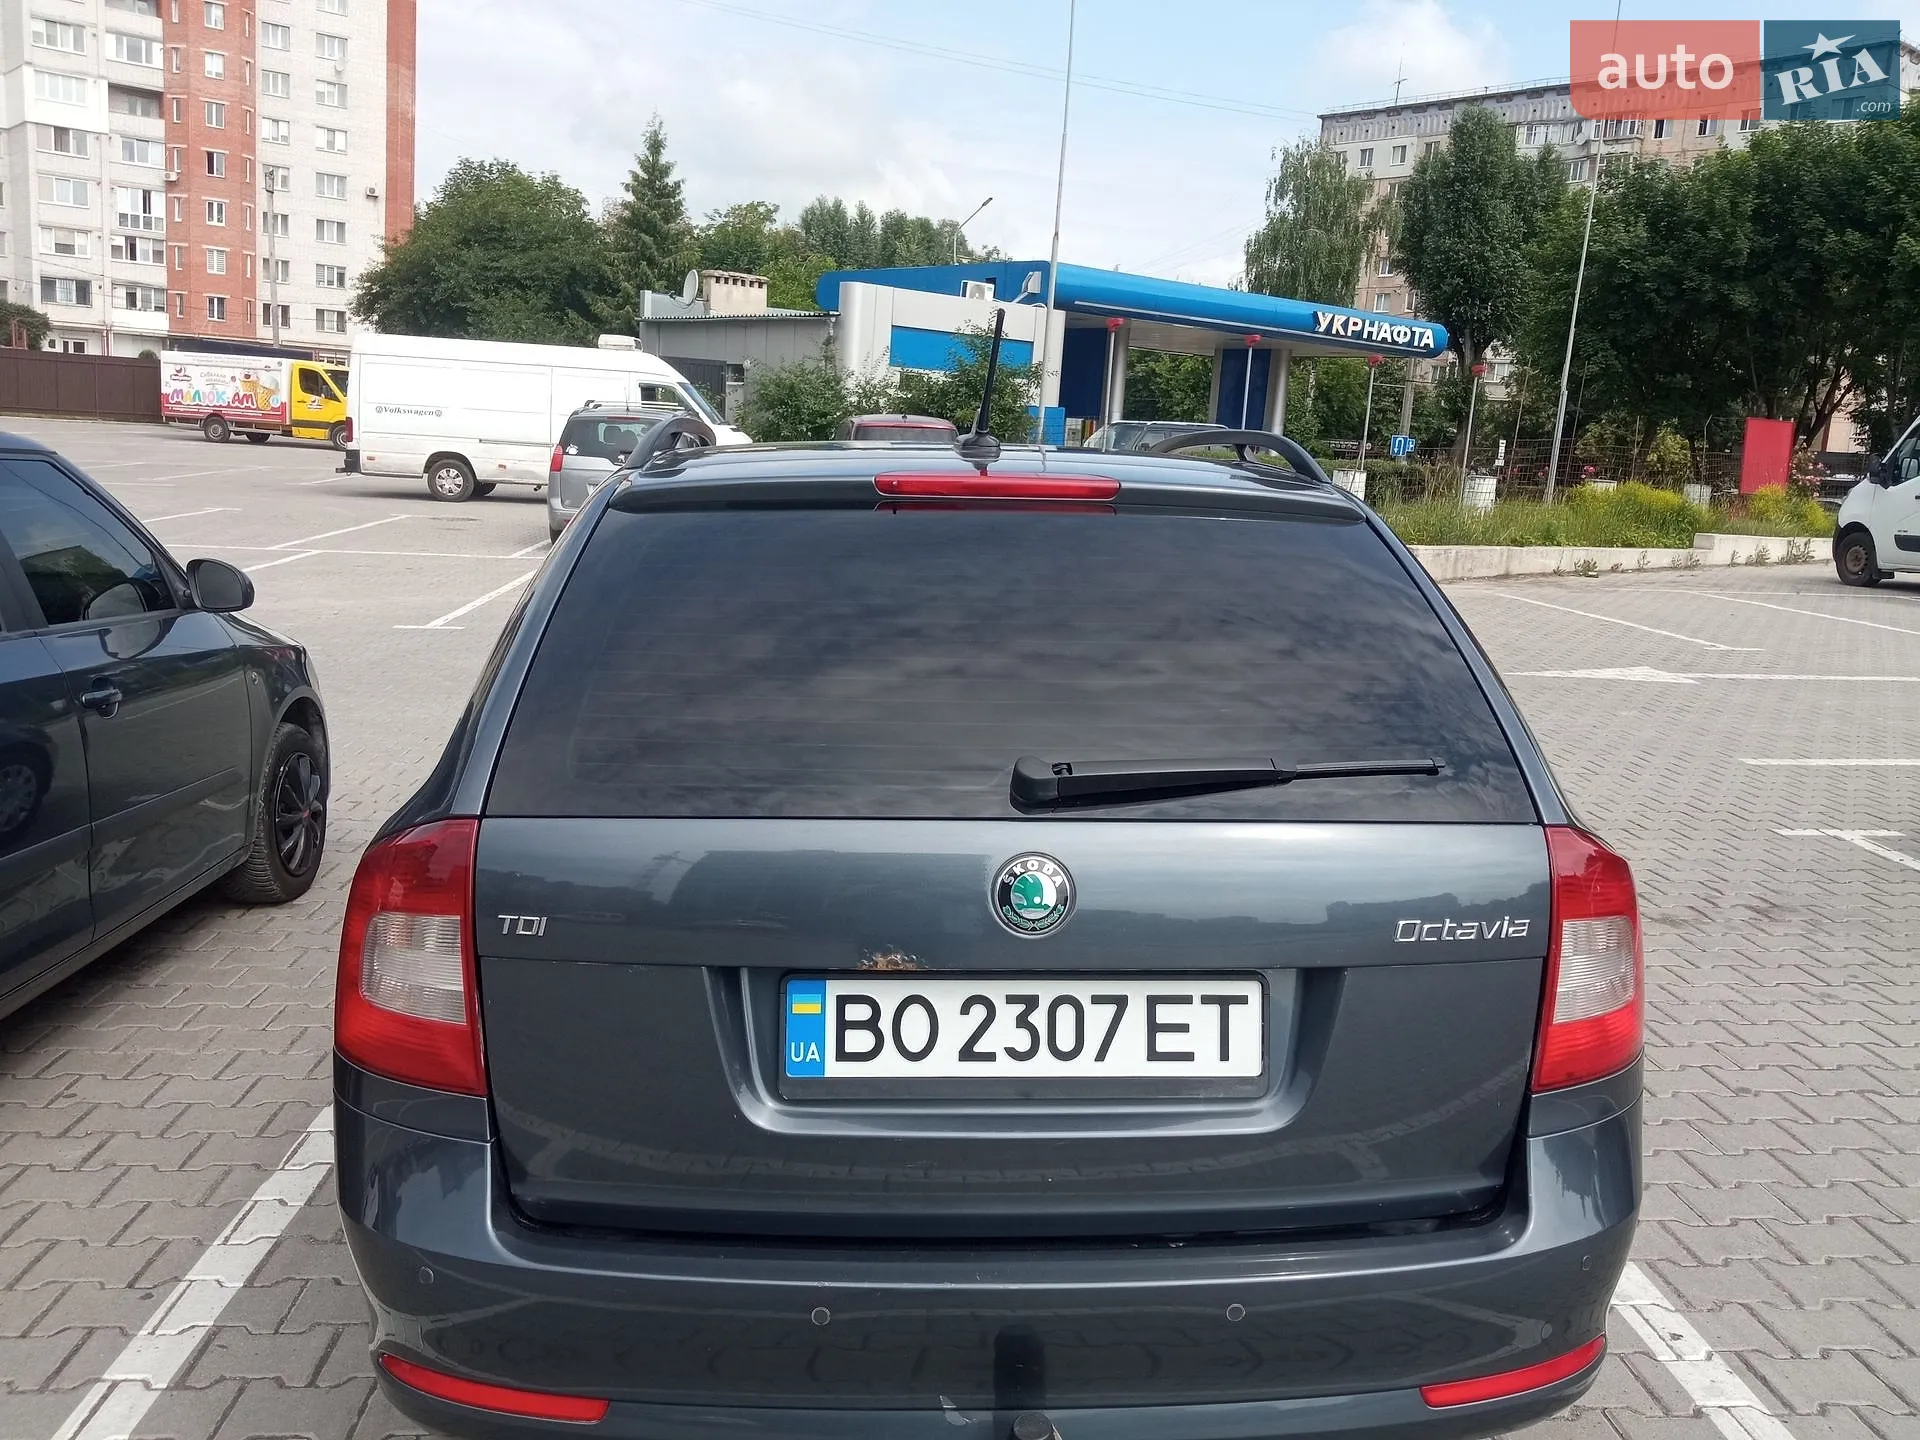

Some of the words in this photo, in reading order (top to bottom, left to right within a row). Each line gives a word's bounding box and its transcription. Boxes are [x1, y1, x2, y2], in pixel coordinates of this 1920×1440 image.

[1315, 311, 1435, 349] УКРНАФТА
[383, 405, 434, 417] Volkswagen
[497, 914, 548, 937] TDI
[1393, 916, 1531, 943] Octavia
[834, 994, 939, 1062] BO
[958, 994, 1129, 1062] 2307
[1147, 994, 1248, 1062] ET
[790, 1041, 821, 1063] UA
